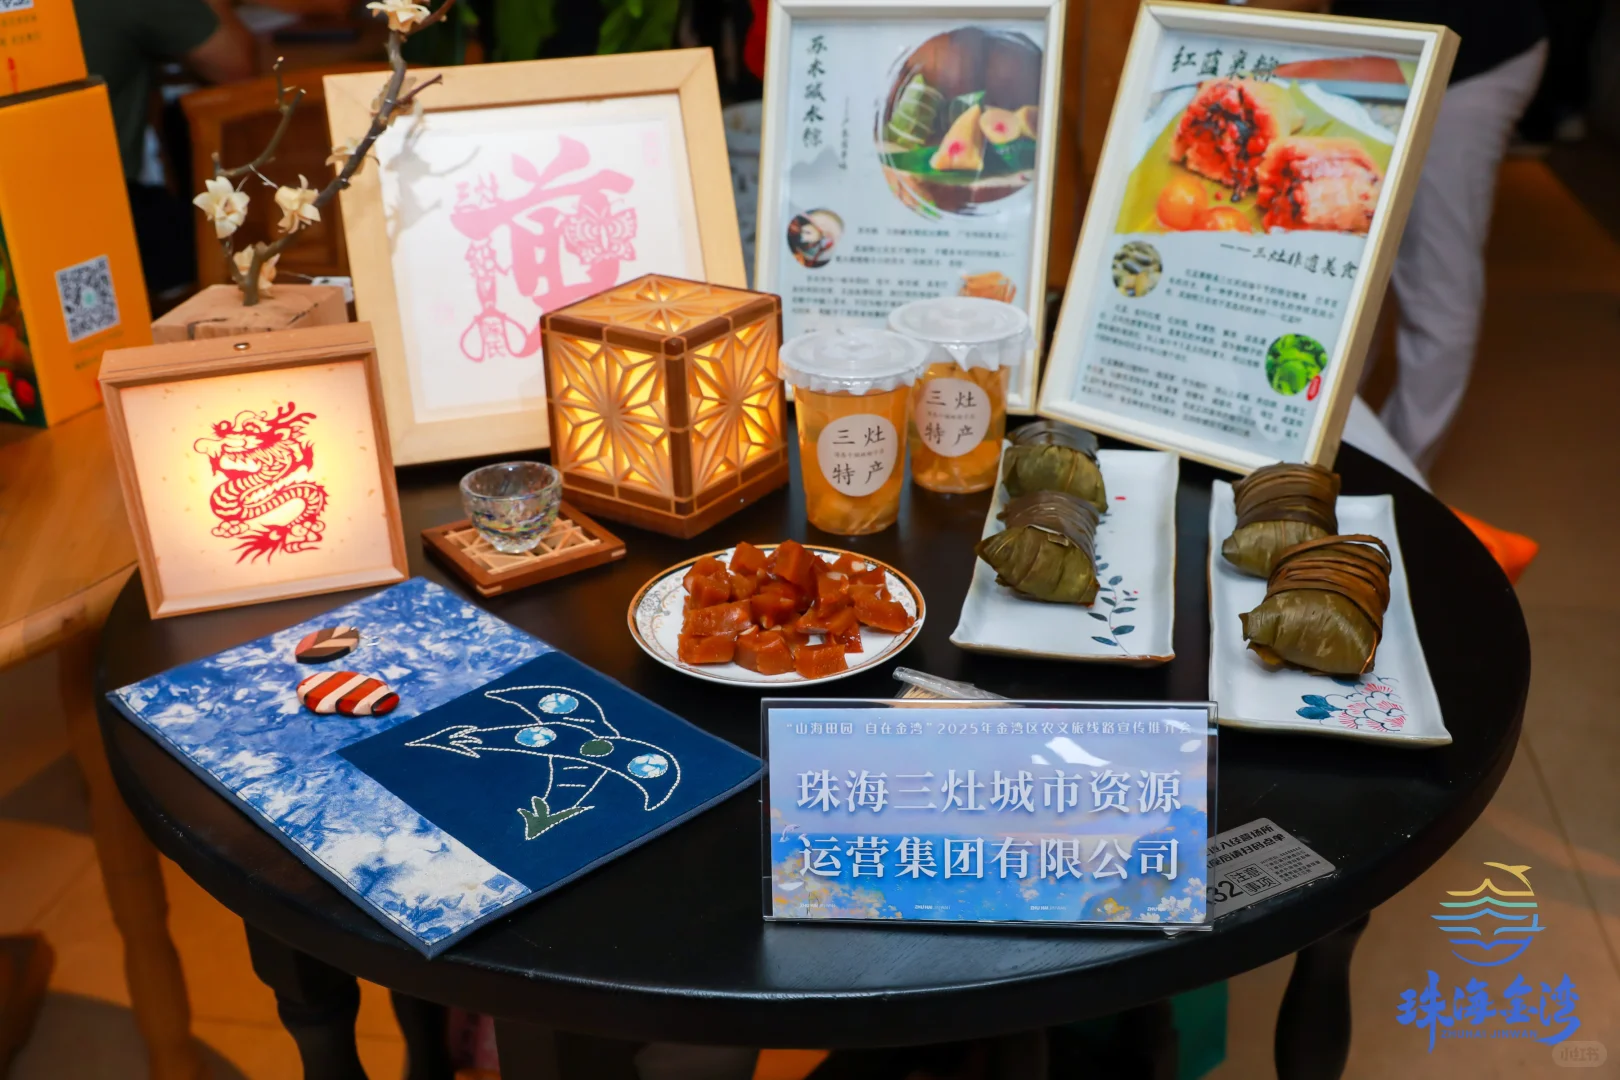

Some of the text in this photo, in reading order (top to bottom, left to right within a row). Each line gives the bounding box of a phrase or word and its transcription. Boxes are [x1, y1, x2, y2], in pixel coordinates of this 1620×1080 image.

[925, 390, 977, 410] 三灶
[832, 425, 886, 447] 三灶
[924, 421, 974, 446] 特产
[832, 460, 885, 486] 特产
[796, 769, 1183, 814] 珠海三灶城市资源
[798, 836, 1180, 881] 运营集团有限公司
